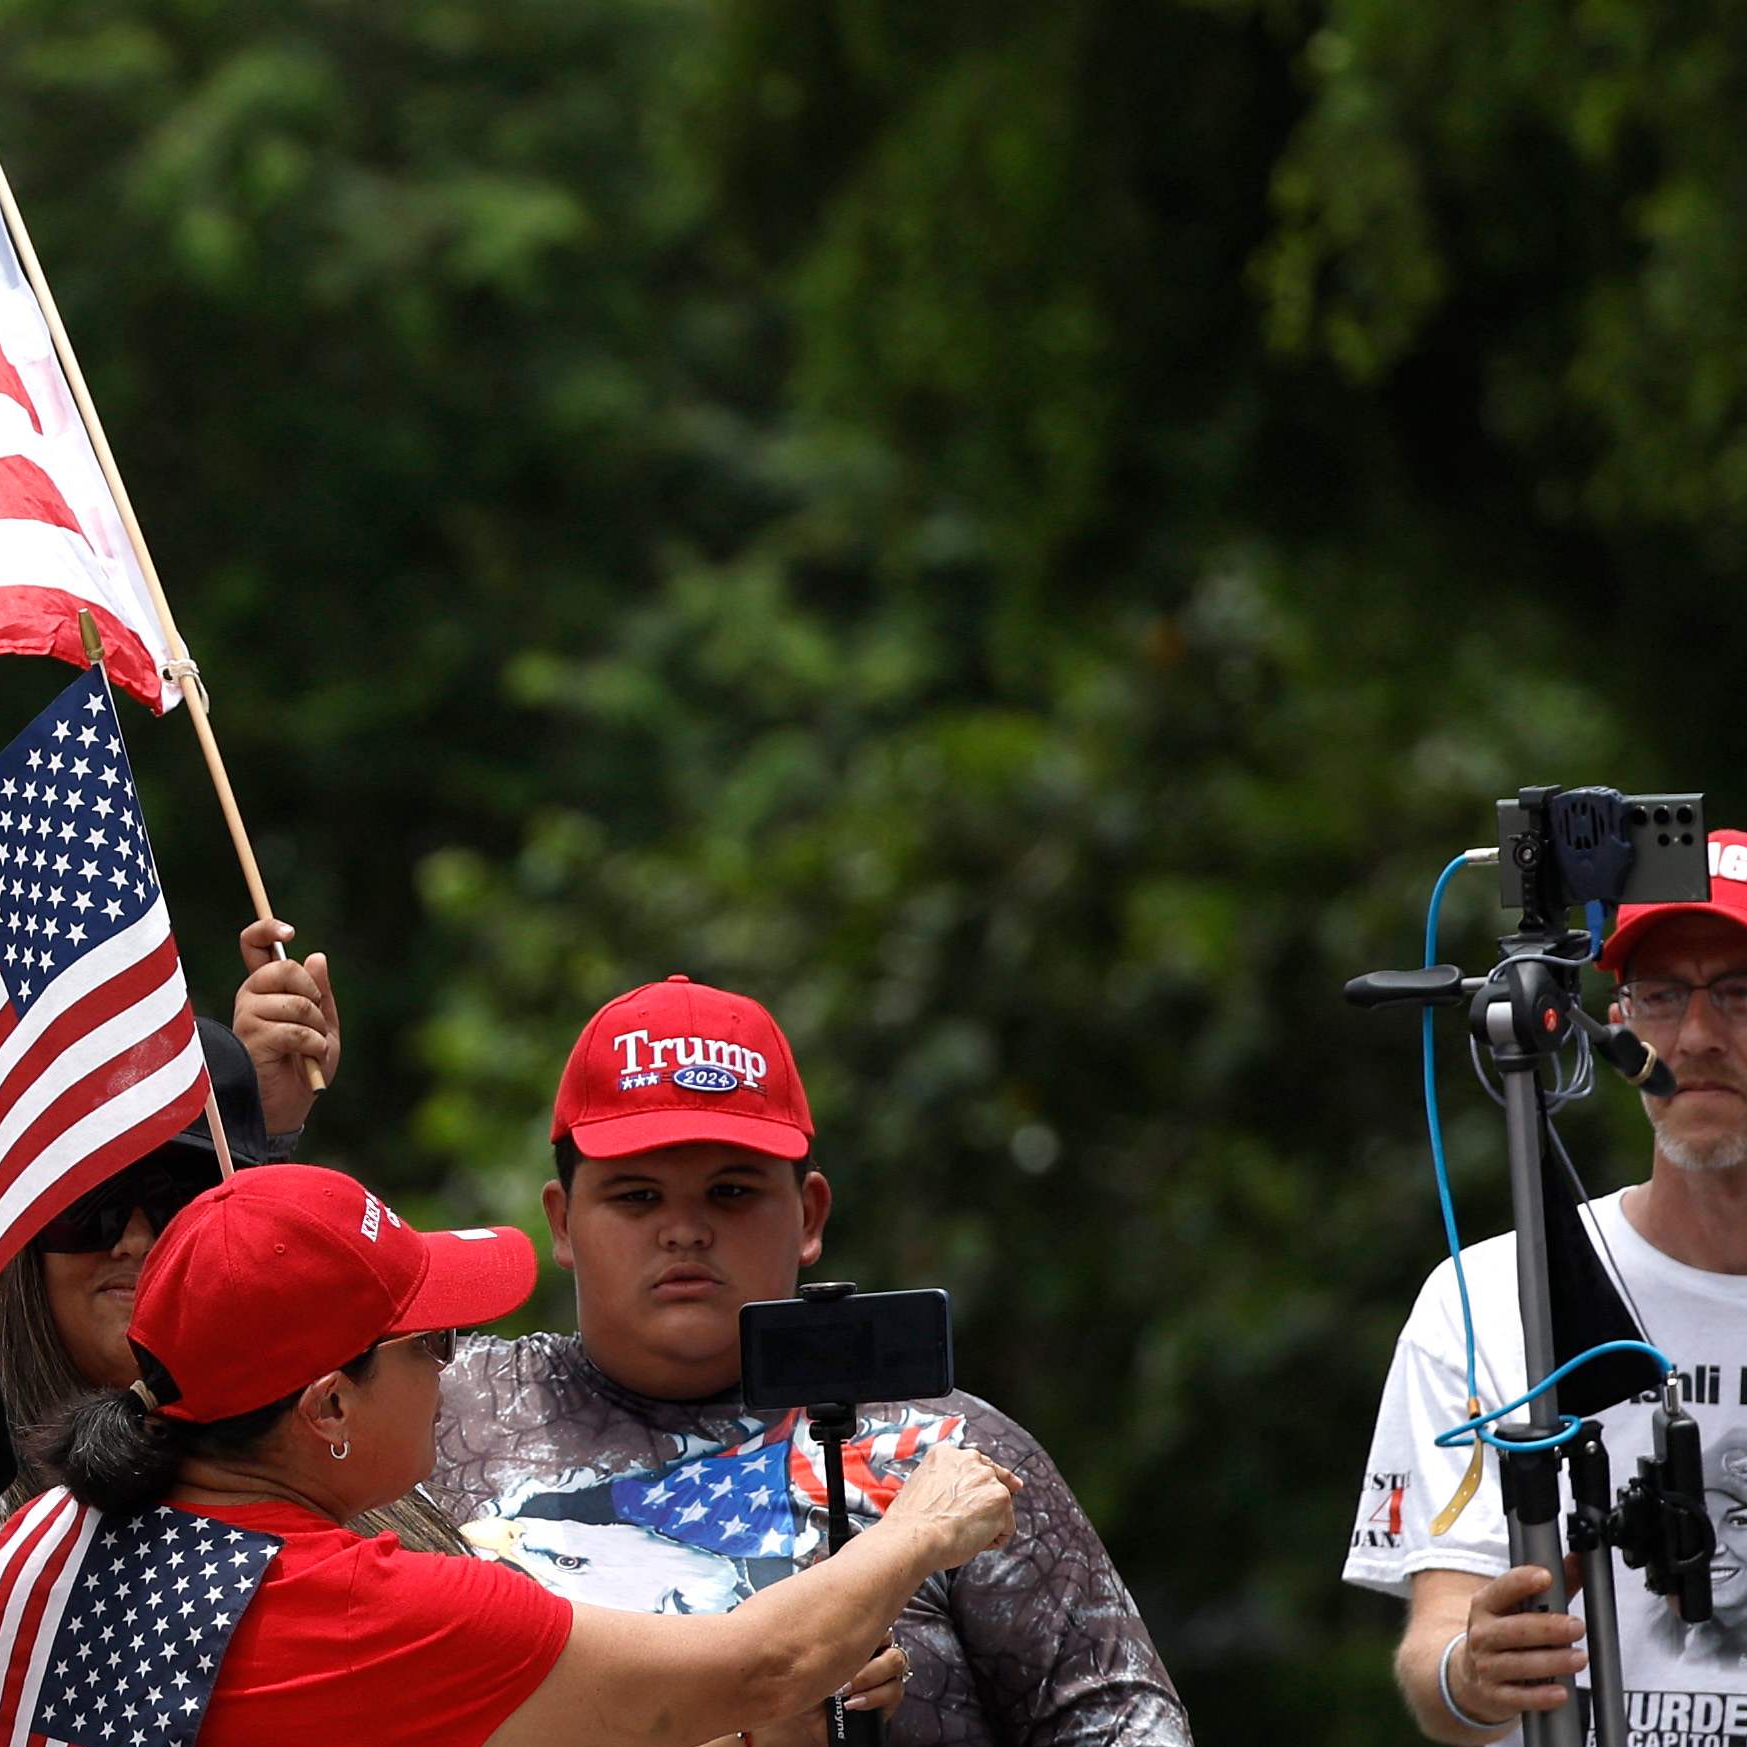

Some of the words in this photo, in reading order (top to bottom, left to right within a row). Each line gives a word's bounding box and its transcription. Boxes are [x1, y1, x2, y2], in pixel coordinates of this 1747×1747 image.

[614, 1030, 767, 1087] Trump
[683, 1070, 730, 1088] 2024
[1369, 1488, 1403, 1535] 4
[1589, 1692, 1747, 1736] URDE
